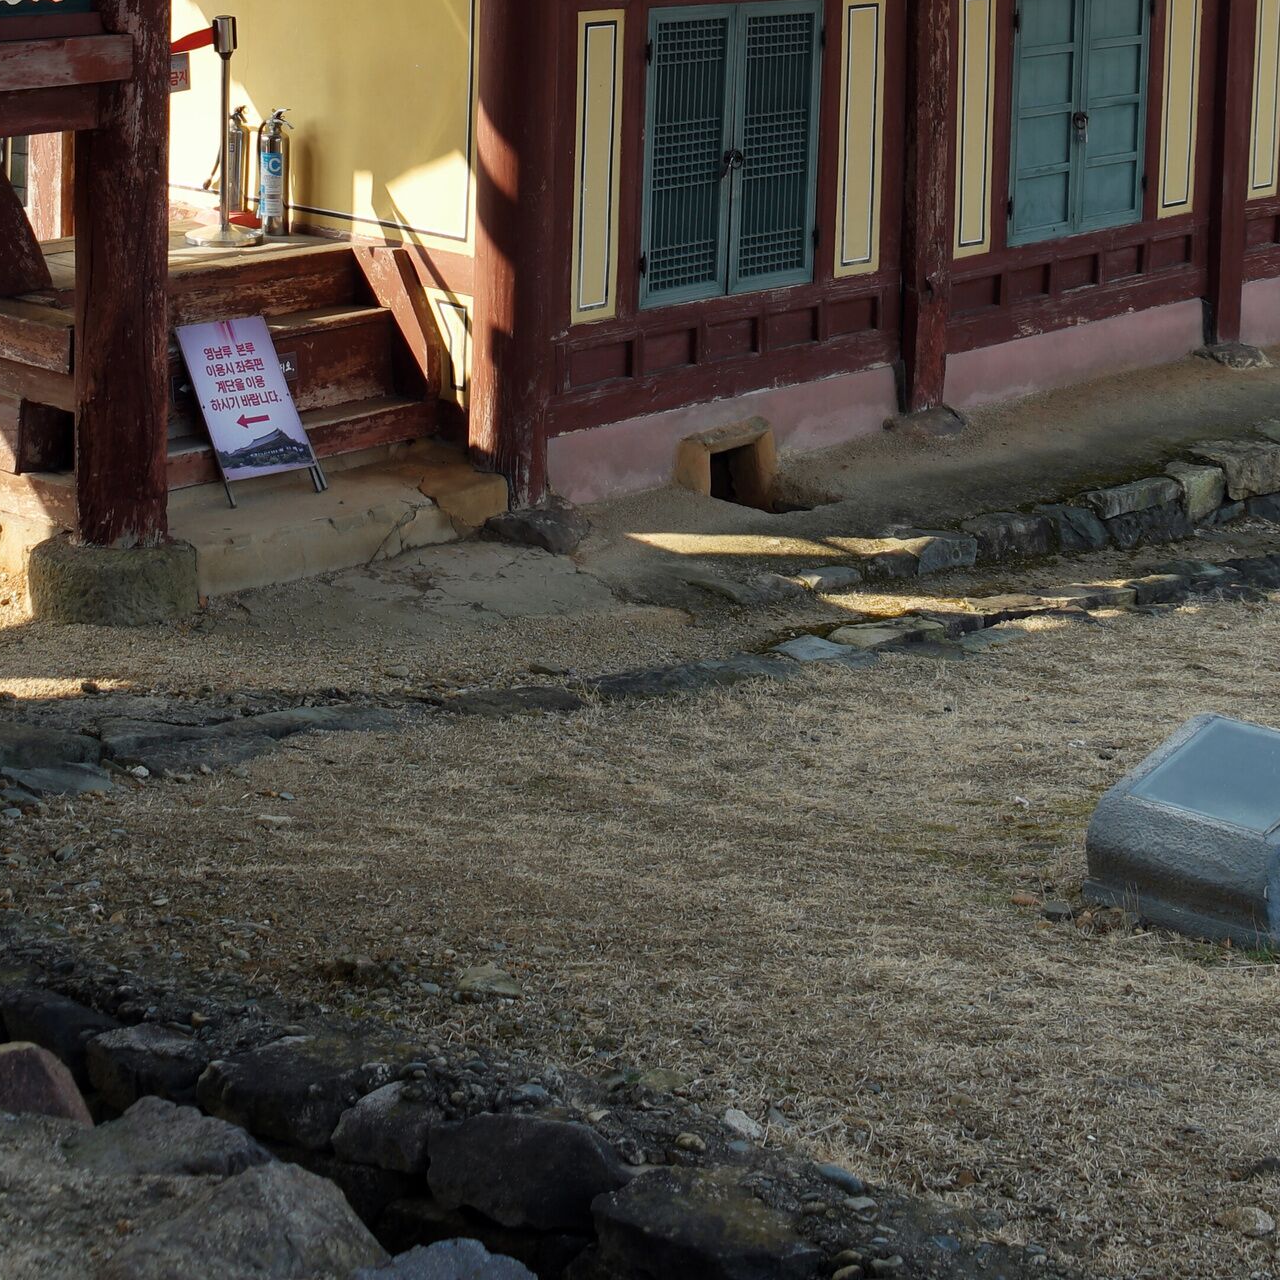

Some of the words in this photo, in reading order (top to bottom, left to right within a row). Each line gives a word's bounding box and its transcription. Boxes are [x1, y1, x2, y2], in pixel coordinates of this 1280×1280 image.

[203, 345, 232, 360] 영남루
[235, 342, 255, 357] 본루
[206, 362, 235, 377] 이용시
[235, 358, 265, 373] 좌측편
[215, 378, 245, 393] 계단을
[245, 375, 265, 389] 이용
[210, 396, 240, 412] 하시기
[240, 390, 282, 407] 바랍니다.
